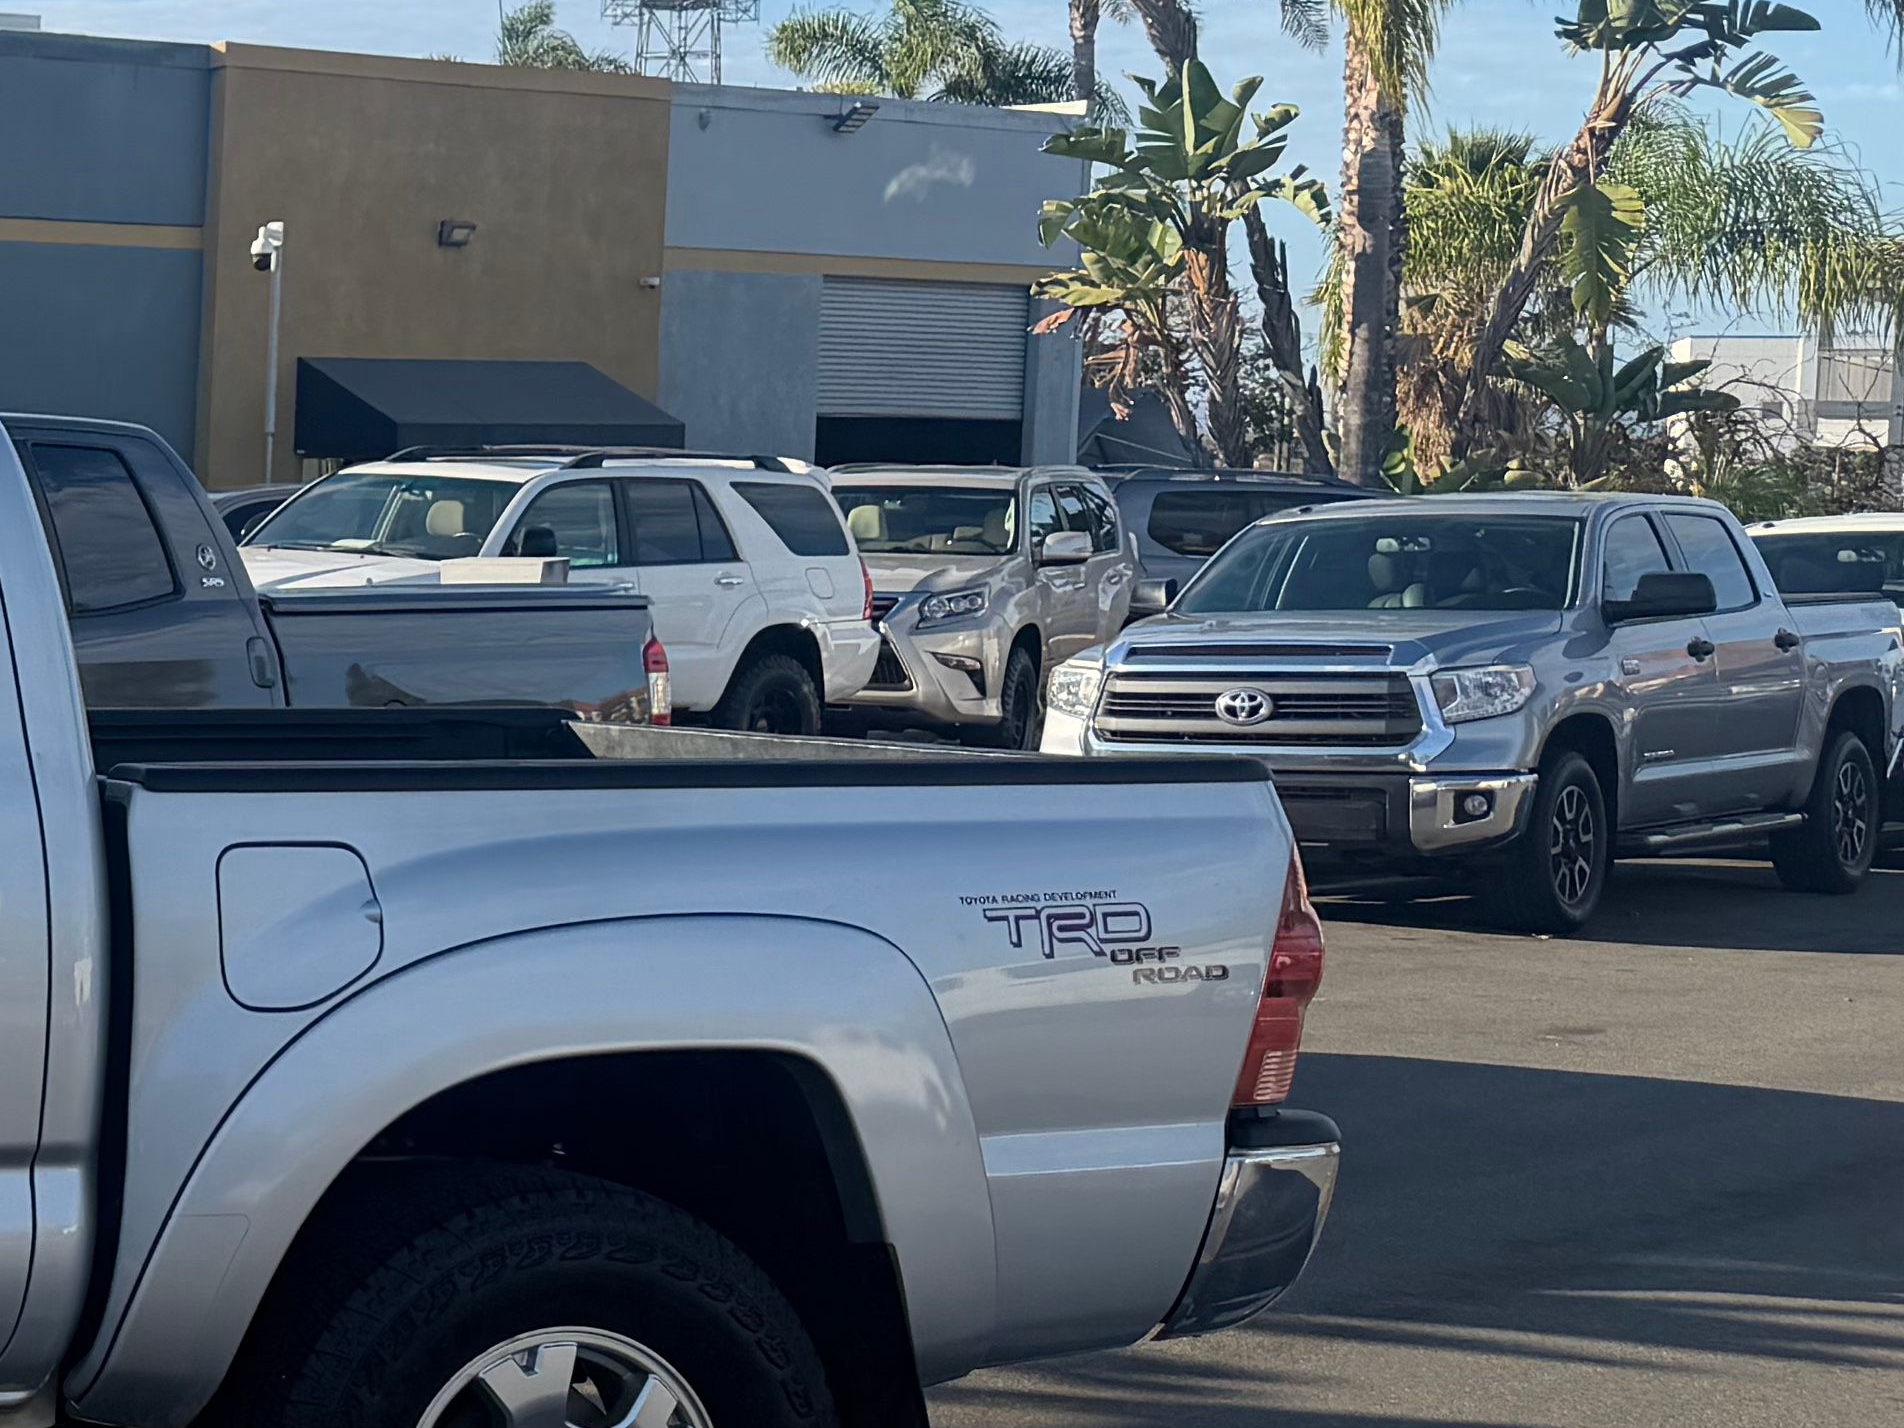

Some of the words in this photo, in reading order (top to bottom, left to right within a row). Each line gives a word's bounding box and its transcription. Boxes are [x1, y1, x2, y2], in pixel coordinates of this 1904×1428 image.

[959, 894, 998, 906] TOYOTA
[1001, 892, 1040, 904] RACING
[1043, 889, 1117, 903] DEVELOPMENT
[983, 902, 1153, 959] TRD
[1109, 946, 1182, 965] OFF
[1132, 965, 1230, 985] ROAD
